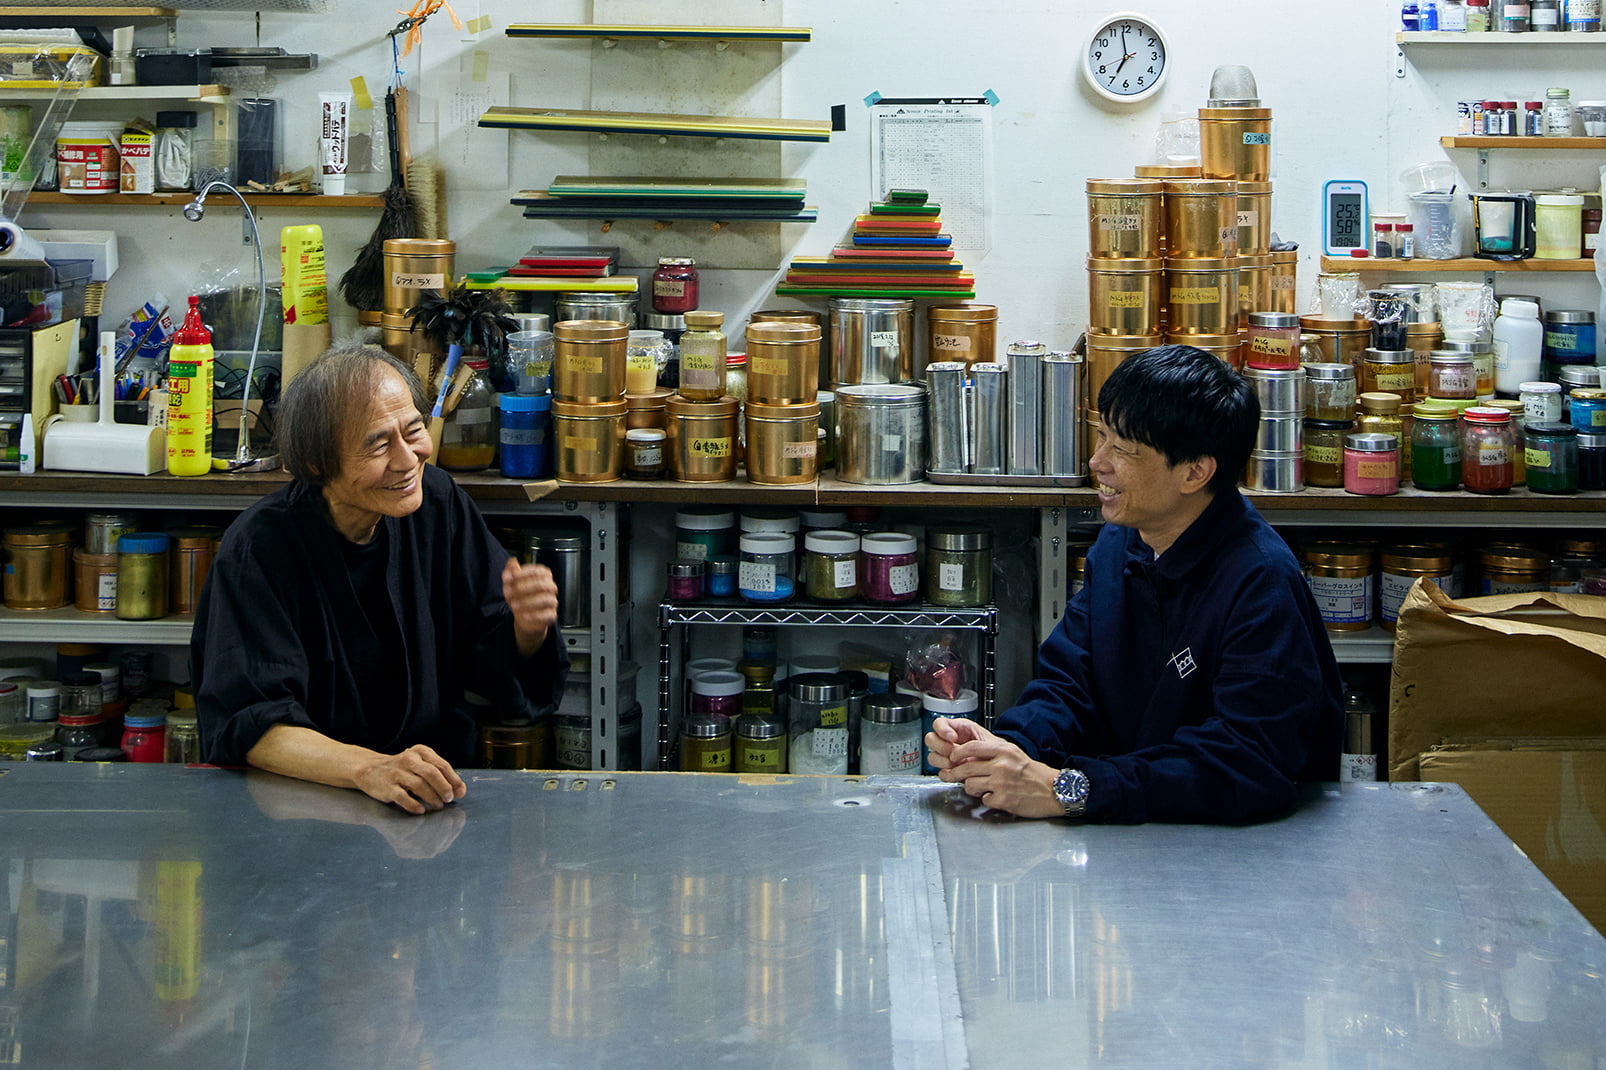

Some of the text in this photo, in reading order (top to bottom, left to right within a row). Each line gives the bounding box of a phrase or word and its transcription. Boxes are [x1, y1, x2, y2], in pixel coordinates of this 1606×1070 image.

[1110, 29, 1116, 37] 11
[1121, 25, 1131, 33] 12
[1138, 28, 1142, 36] 1
[1099, 38, 1108, 47] 10
[1147, 38, 1155, 47] 2
[1095, 51, 1102, 61] 9
[1151, 52, 1158, 61] 3
[1099, 65, 1106, 74] 8
[1147, 65, 1153, 74] 4
[1109, 76, 1116, 84] 7
[1122, 79, 1129, 88] 6
[1137, 76, 1144, 85] 5
[1337, 219, 1353, 234] 58
